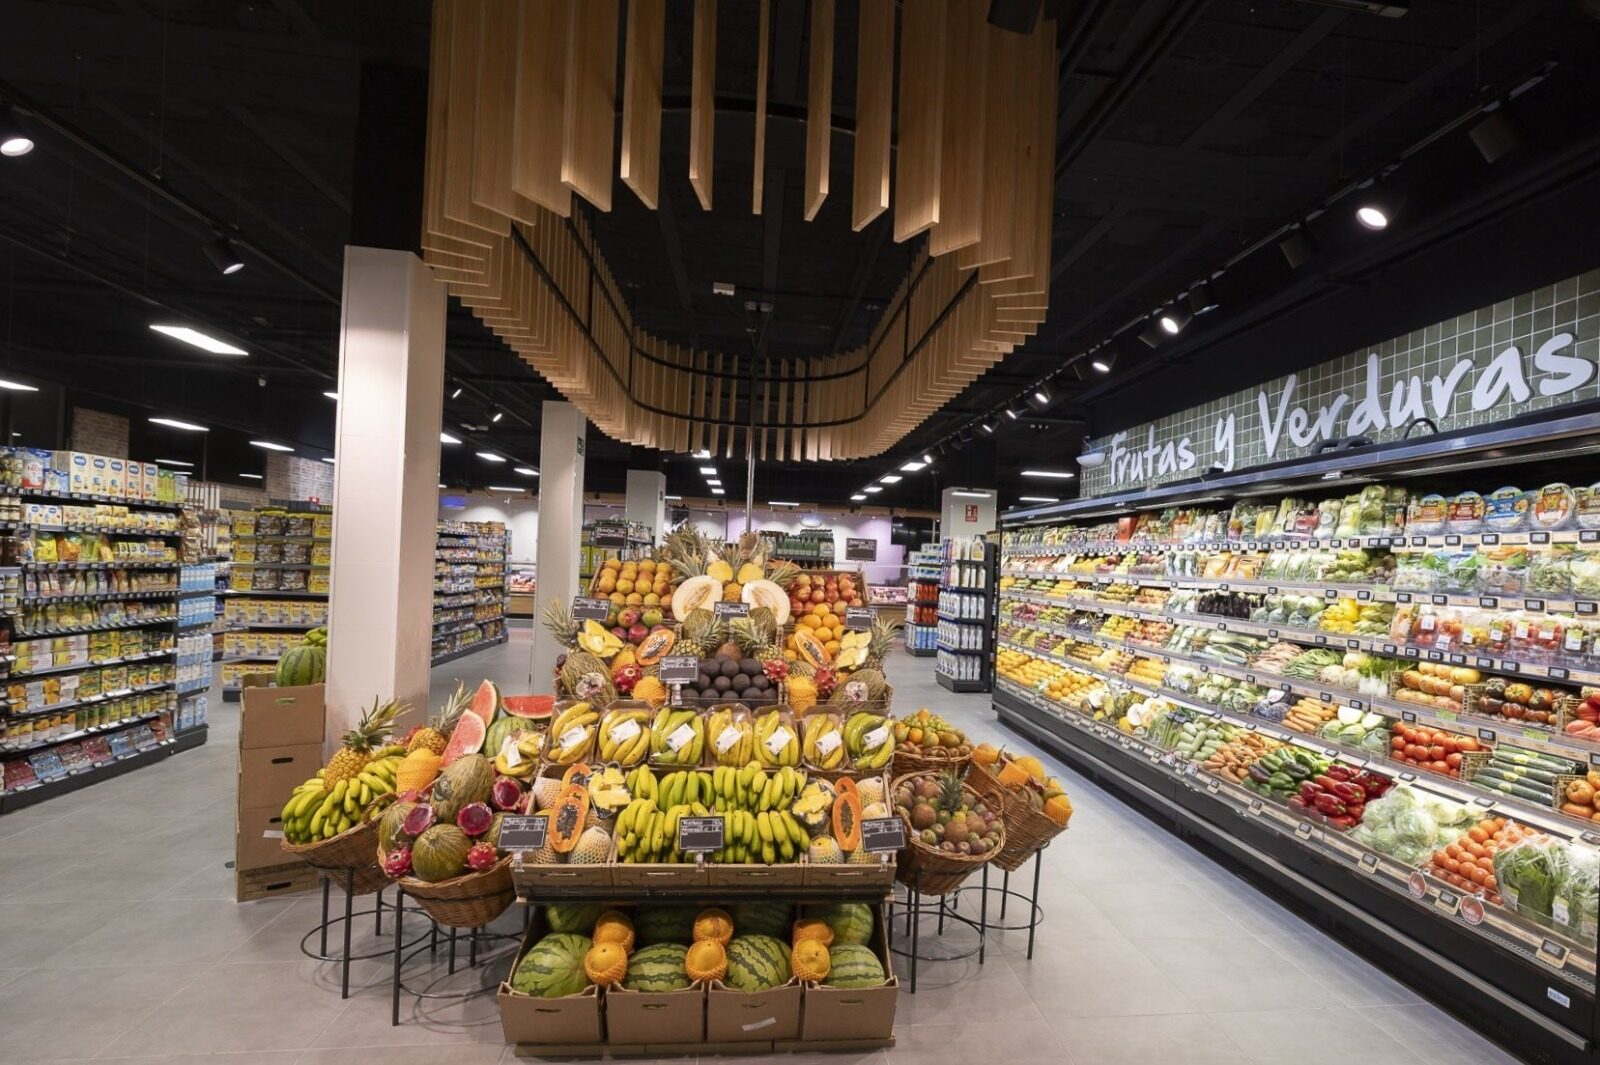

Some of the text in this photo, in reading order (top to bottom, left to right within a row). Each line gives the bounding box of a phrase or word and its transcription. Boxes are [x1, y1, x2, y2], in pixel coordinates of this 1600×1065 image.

[1109, 332, 1598, 486] Frutas y Verduras
